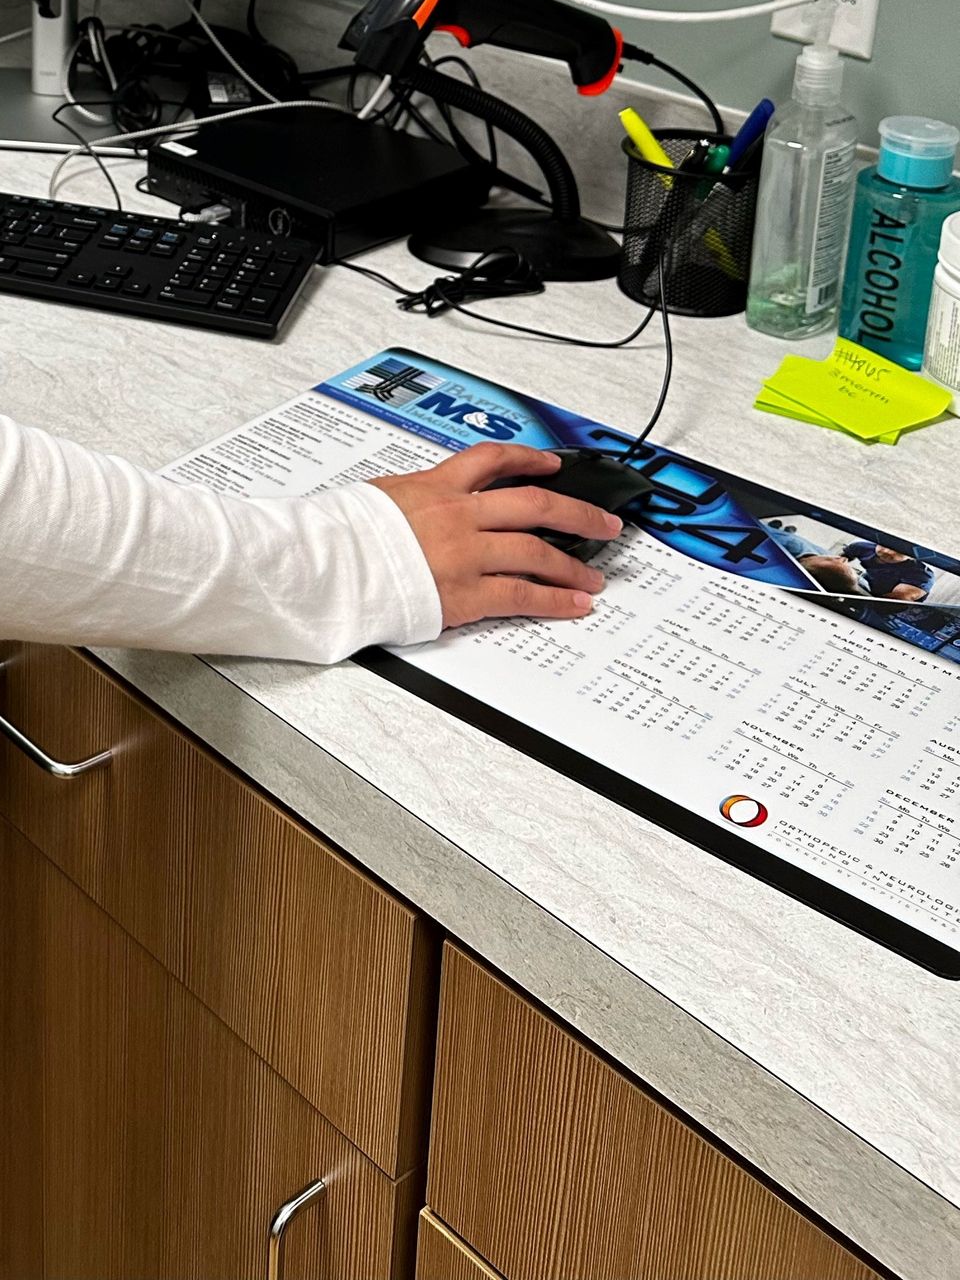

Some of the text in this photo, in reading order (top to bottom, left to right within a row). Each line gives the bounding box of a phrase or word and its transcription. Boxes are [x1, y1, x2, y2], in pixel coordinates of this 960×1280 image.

[858, 207, 906, 344] ALCOHOL
[416, 392, 522, 440] M&S
[446, 381, 533, 424] BAPTIST
[404, 406, 472, 438] IMAGING
[708, 580, 760, 604] FEBRUARY
[662, 619, 690, 632] JUNE
[832, 634, 872, 652] MARCH
[613, 658, 662, 684] OCTOBER
[789, 675, 818, 689] JULY
[742, 720, 804, 752] NOVEMBER
[787, 752, 799, 760] We
[809, 761, 818, 770] Th
[886, 789, 955, 824] DECEMBER
[774, 826, 850, 866] IMAGING
[778, 820, 860, 863] ORTHOPEDIC
